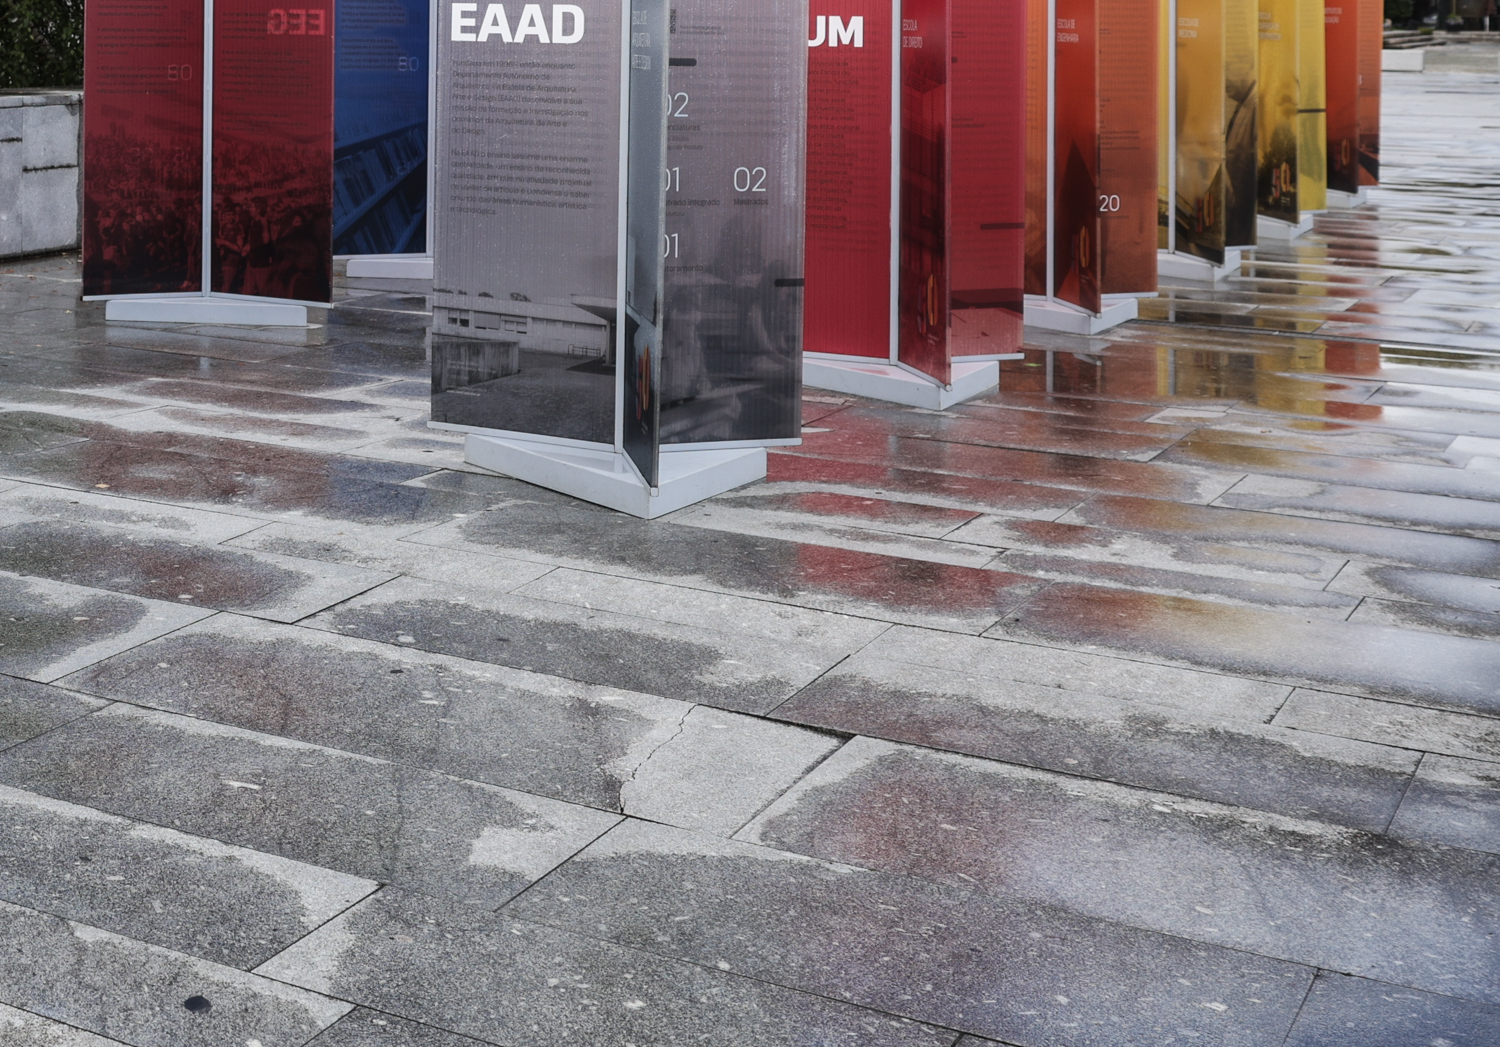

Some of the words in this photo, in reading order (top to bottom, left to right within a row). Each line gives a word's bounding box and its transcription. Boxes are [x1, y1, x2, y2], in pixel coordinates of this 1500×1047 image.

[451, 2, 585, 44] EAAD
[733, 166, 767, 192] 02
[1100, 195, 1120, 212] 20
